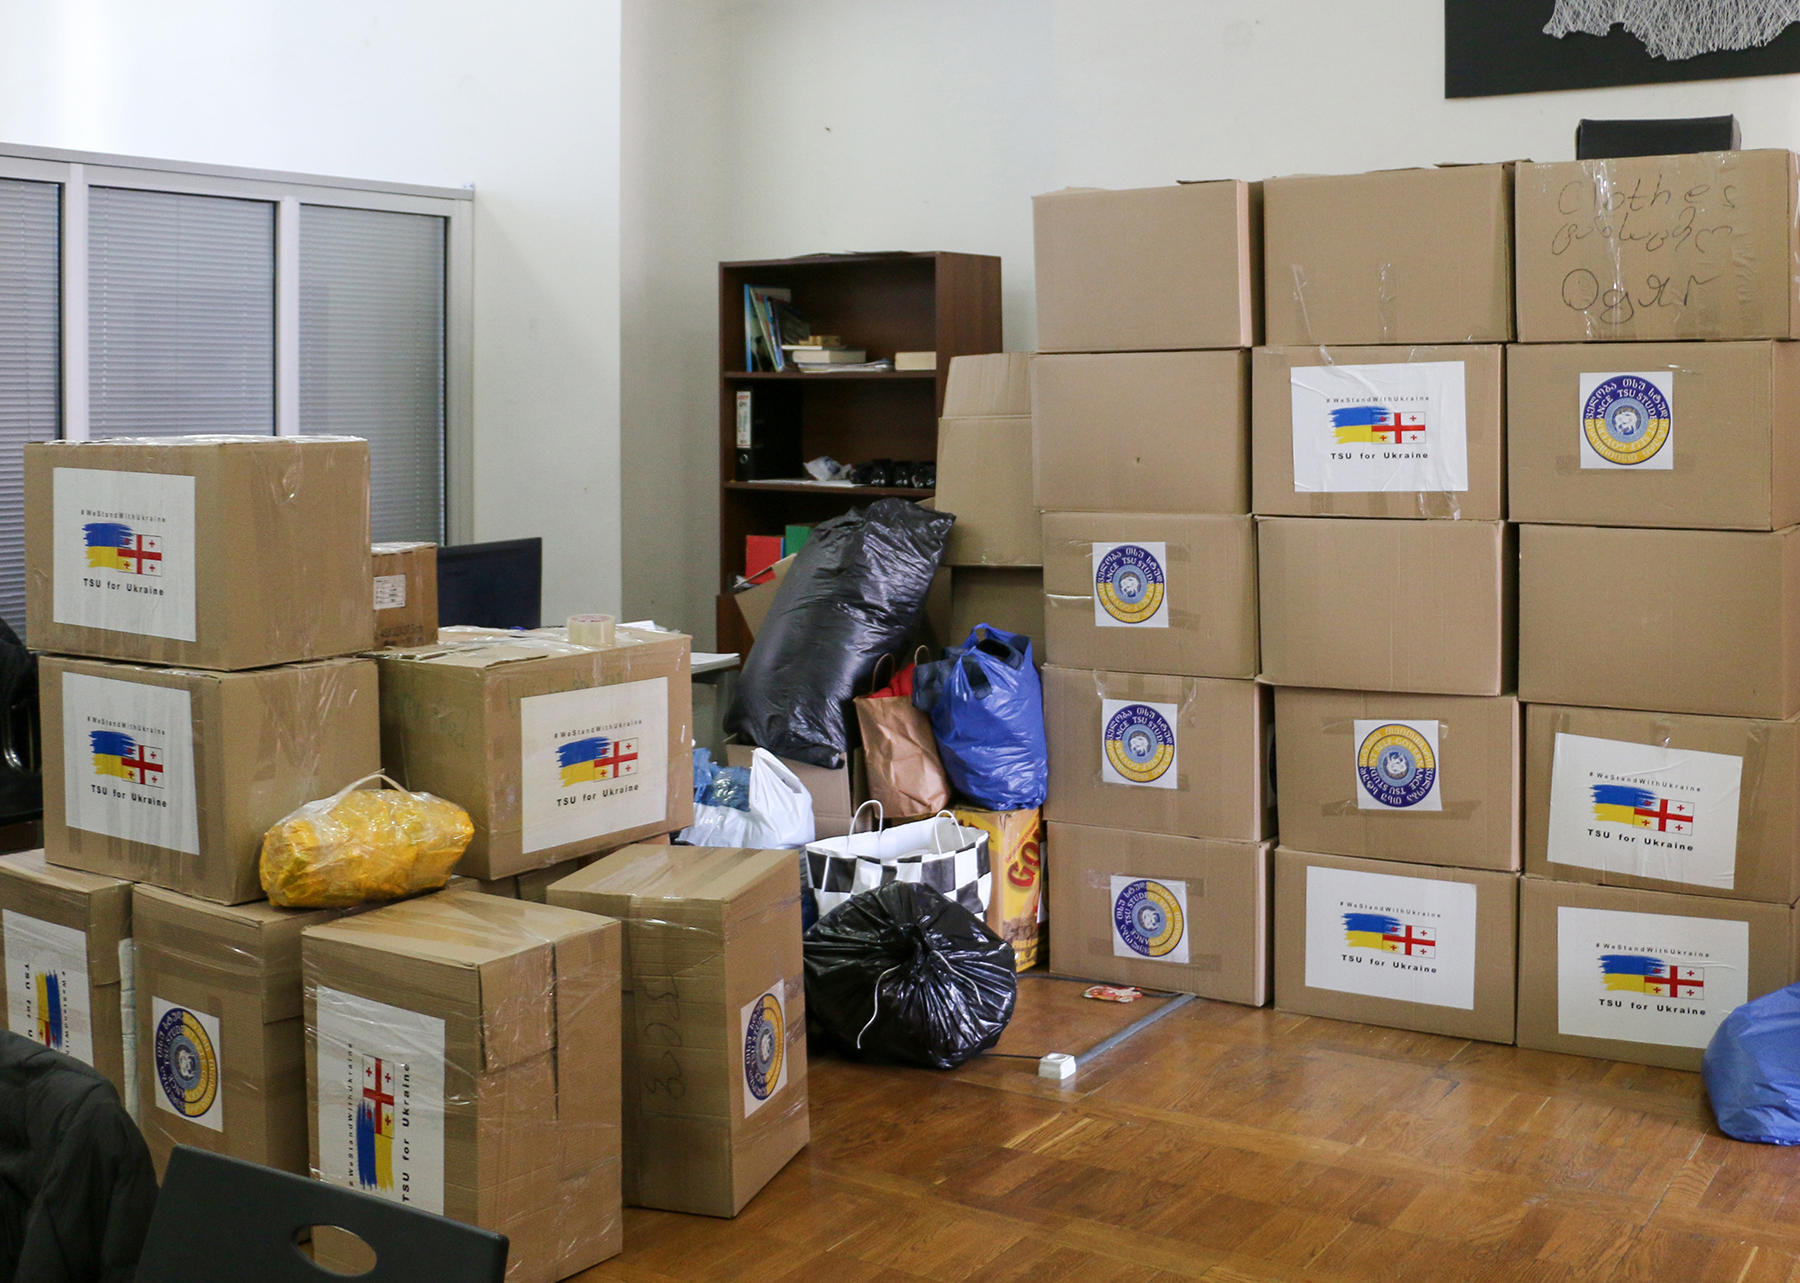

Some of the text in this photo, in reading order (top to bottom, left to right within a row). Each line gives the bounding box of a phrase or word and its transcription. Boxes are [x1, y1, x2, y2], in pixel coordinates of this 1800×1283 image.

[1558, 174, 1736, 215] Clothes
[1617, 389, 1636, 398] TSU
[1331, 452, 1352, 460] TSU
[1121, 557, 1137, 565] TSU
[83, 577, 165, 596] TSU for Ukraine
[1131, 716, 1147, 725] TSU
[91, 784, 167, 807] TSU for Ukraine
[556, 784, 639, 807] TSU for Ukraine
[1388, 787, 1406, 795] TSU
[1587, 828, 1694, 852] TSU for Ukraine
[1342, 953, 1438, 974] TSU for Ukraine
[1598, 998, 1706, 1016] TSU for Ukraine
[402, 1064, 410, 1203] TSU for Ukraine
